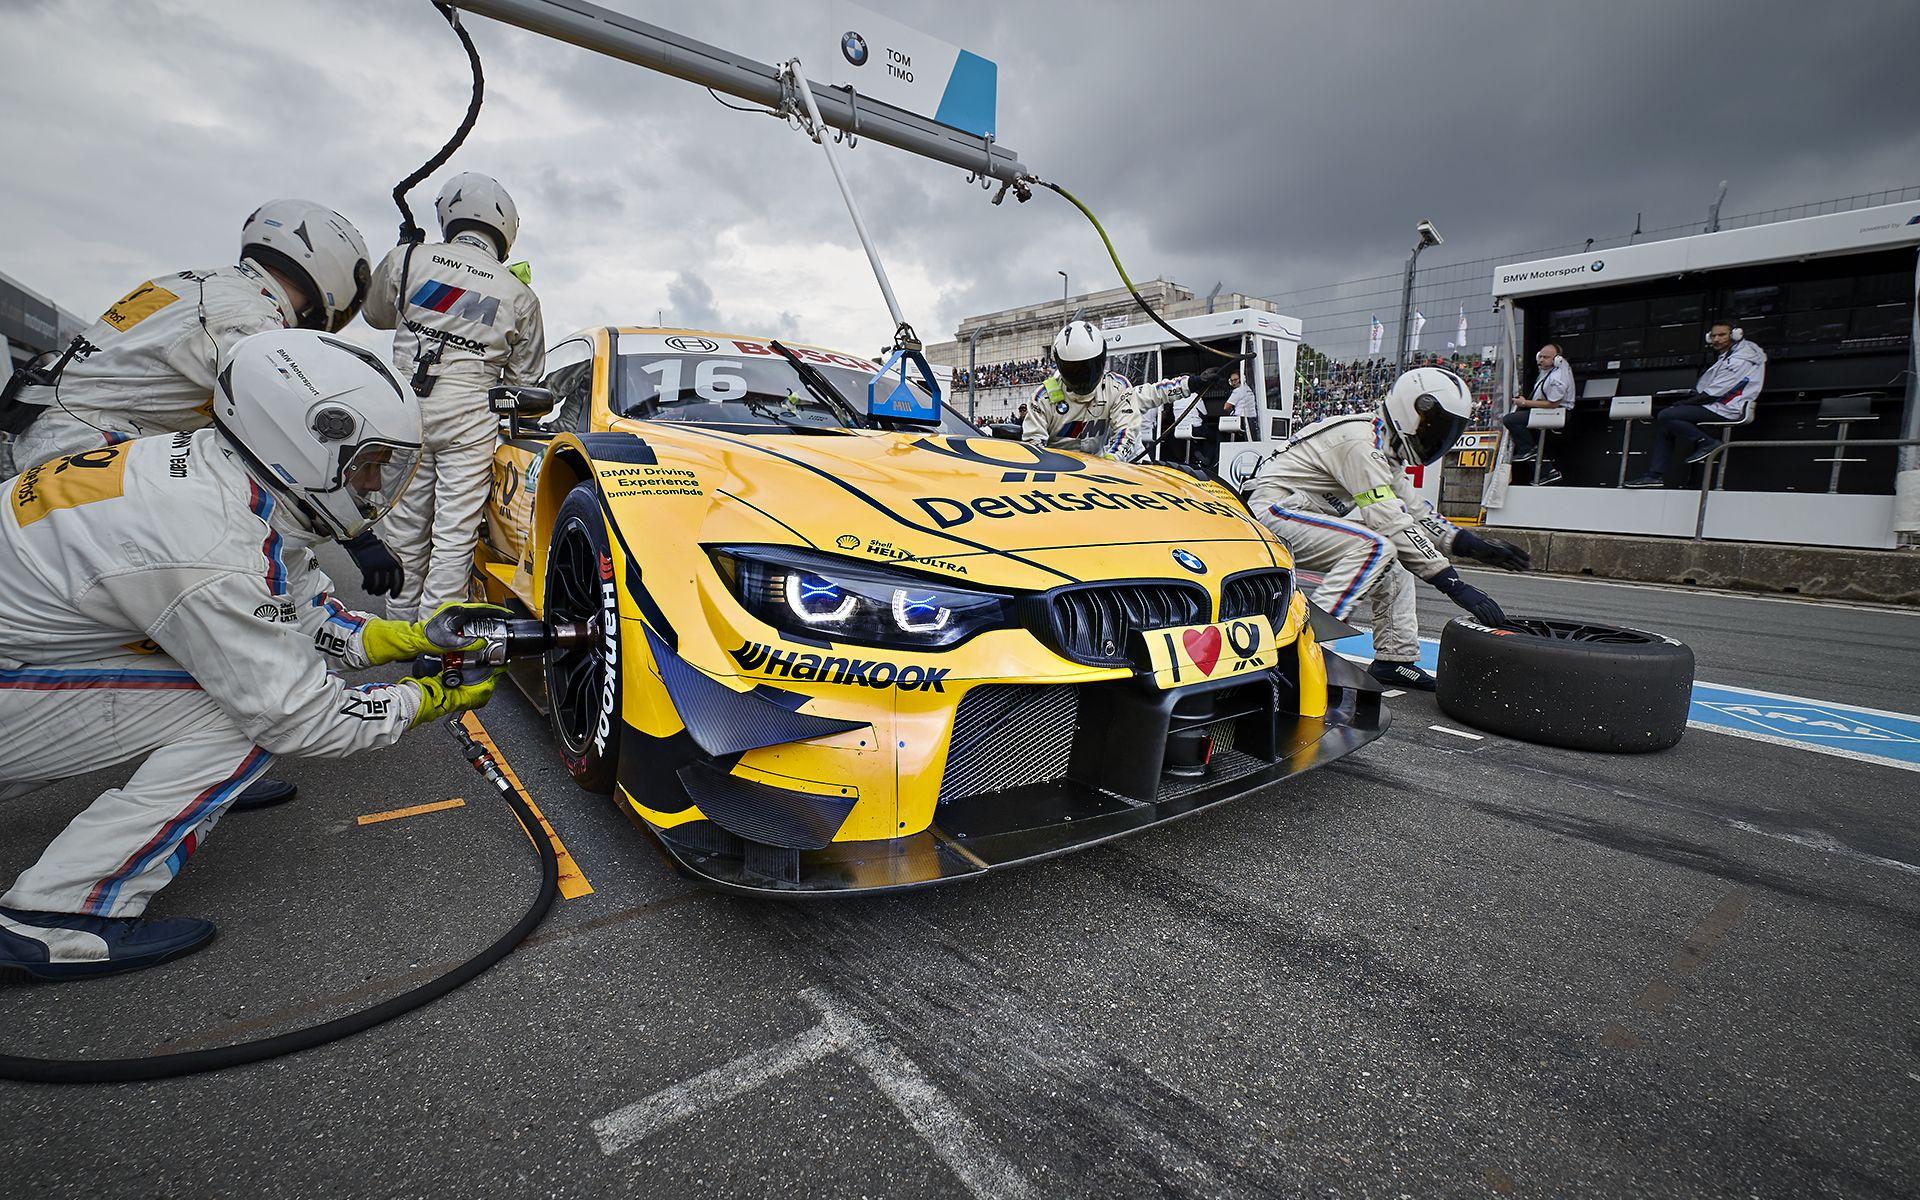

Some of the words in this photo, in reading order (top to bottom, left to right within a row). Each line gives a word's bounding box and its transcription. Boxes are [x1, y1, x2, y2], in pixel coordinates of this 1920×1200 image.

[886, 48, 911, 67] TOM
[886, 63, 914, 83] TIMO
[432, 255, 462, 270] BMW
[466, 265, 494, 280] Team
[1503, 272, 1528, 283] BMW
[1530, 265, 1585, 280] Motorsport
[277, 348, 293, 363] BMW
[289, 361, 320, 397] Motorsport
[641, 359, 748, 408] 16
[494, 399, 515, 408] PUMA
[169, 448, 191, 478] Team
[1470, 451, 1487, 466] 10
[600, 469, 640, 477] BMW
[644, 468, 696, 478] Driving
[618, 478, 699, 487] Experience
[607, 488, 703, 498] bmw-m.com/bde
[912, 487, 1160, 529] Deutsche
[1150, 491, 1249, 522] Post
[870, 540, 892, 549] Shell
[1404, 528, 1438, 560] Zollner
[867, 545, 919, 562] HELIX
[919, 558, 968, 574] ULTRA
[594, 582, 618, 758] Hankook
[1163, 633, 1181, 683] I
[763, 649, 951, 693] Hankook
[1396, 665, 1421, 682] PUMA
[1721, 706, 1891, 739] ARAL
